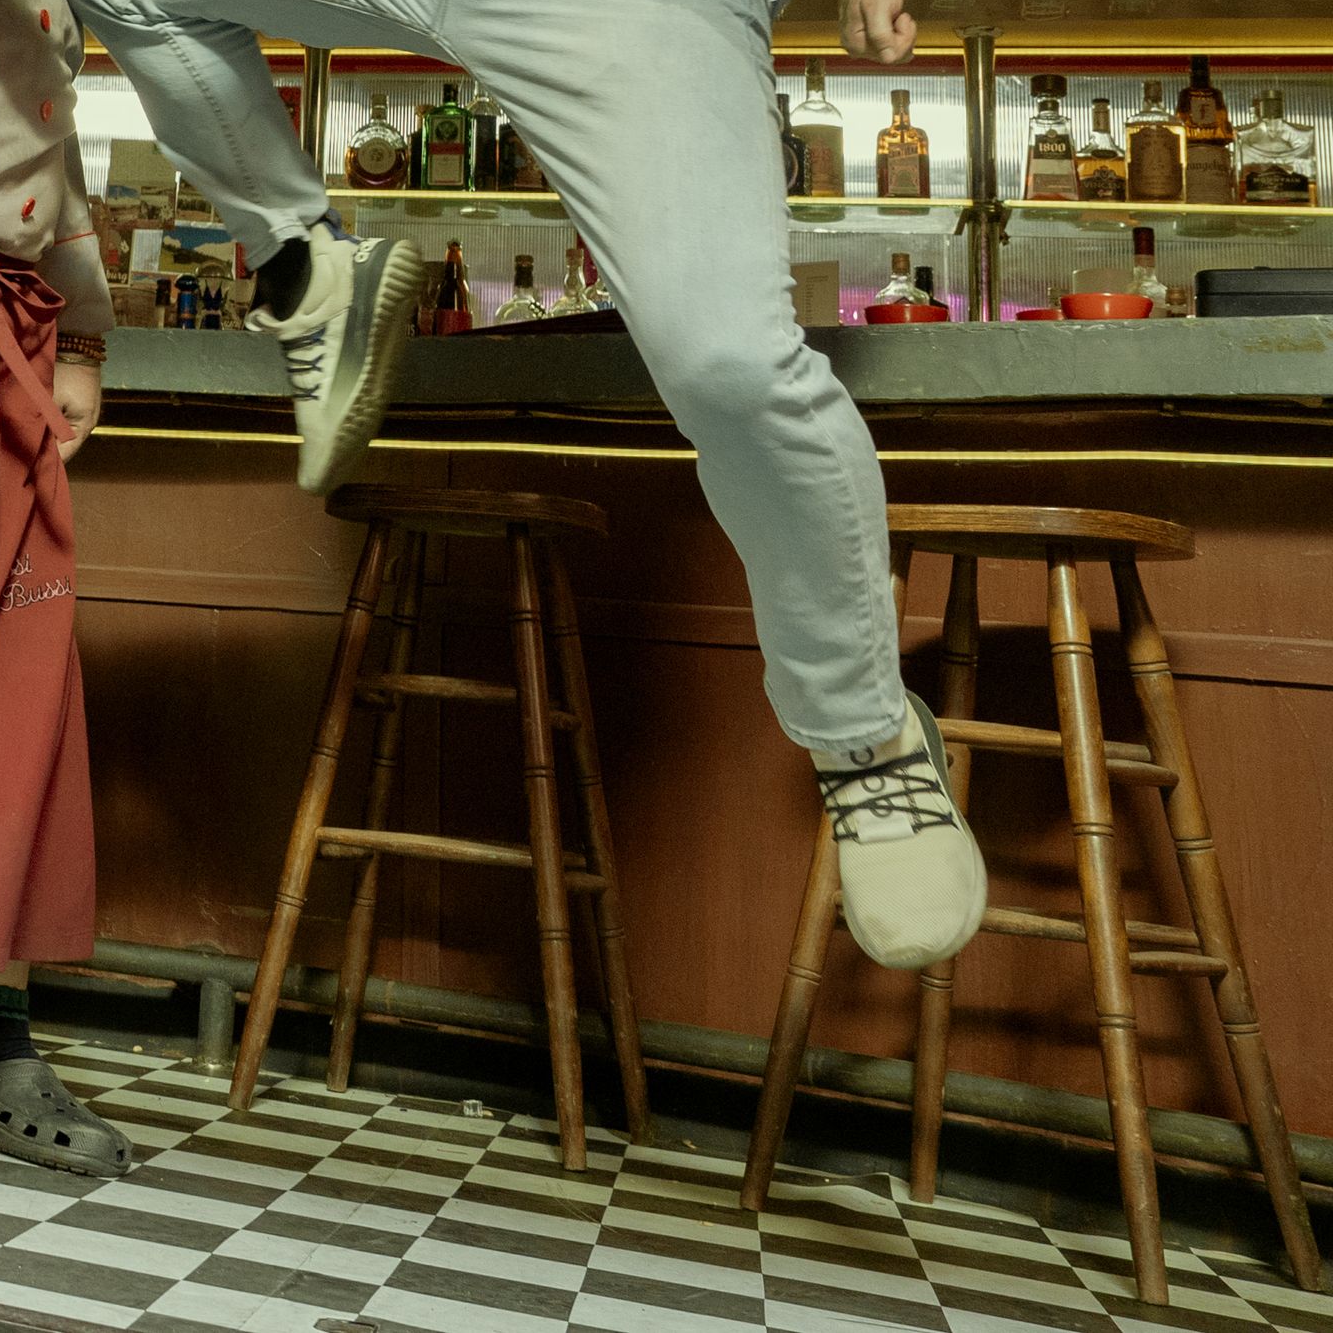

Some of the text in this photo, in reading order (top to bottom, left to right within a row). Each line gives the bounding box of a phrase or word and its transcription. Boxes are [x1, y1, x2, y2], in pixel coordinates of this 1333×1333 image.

[1037, 142, 1067, 154] 1800
[105, 269, 128, 284] burg
[0, 575, 74, 612] Bussi
